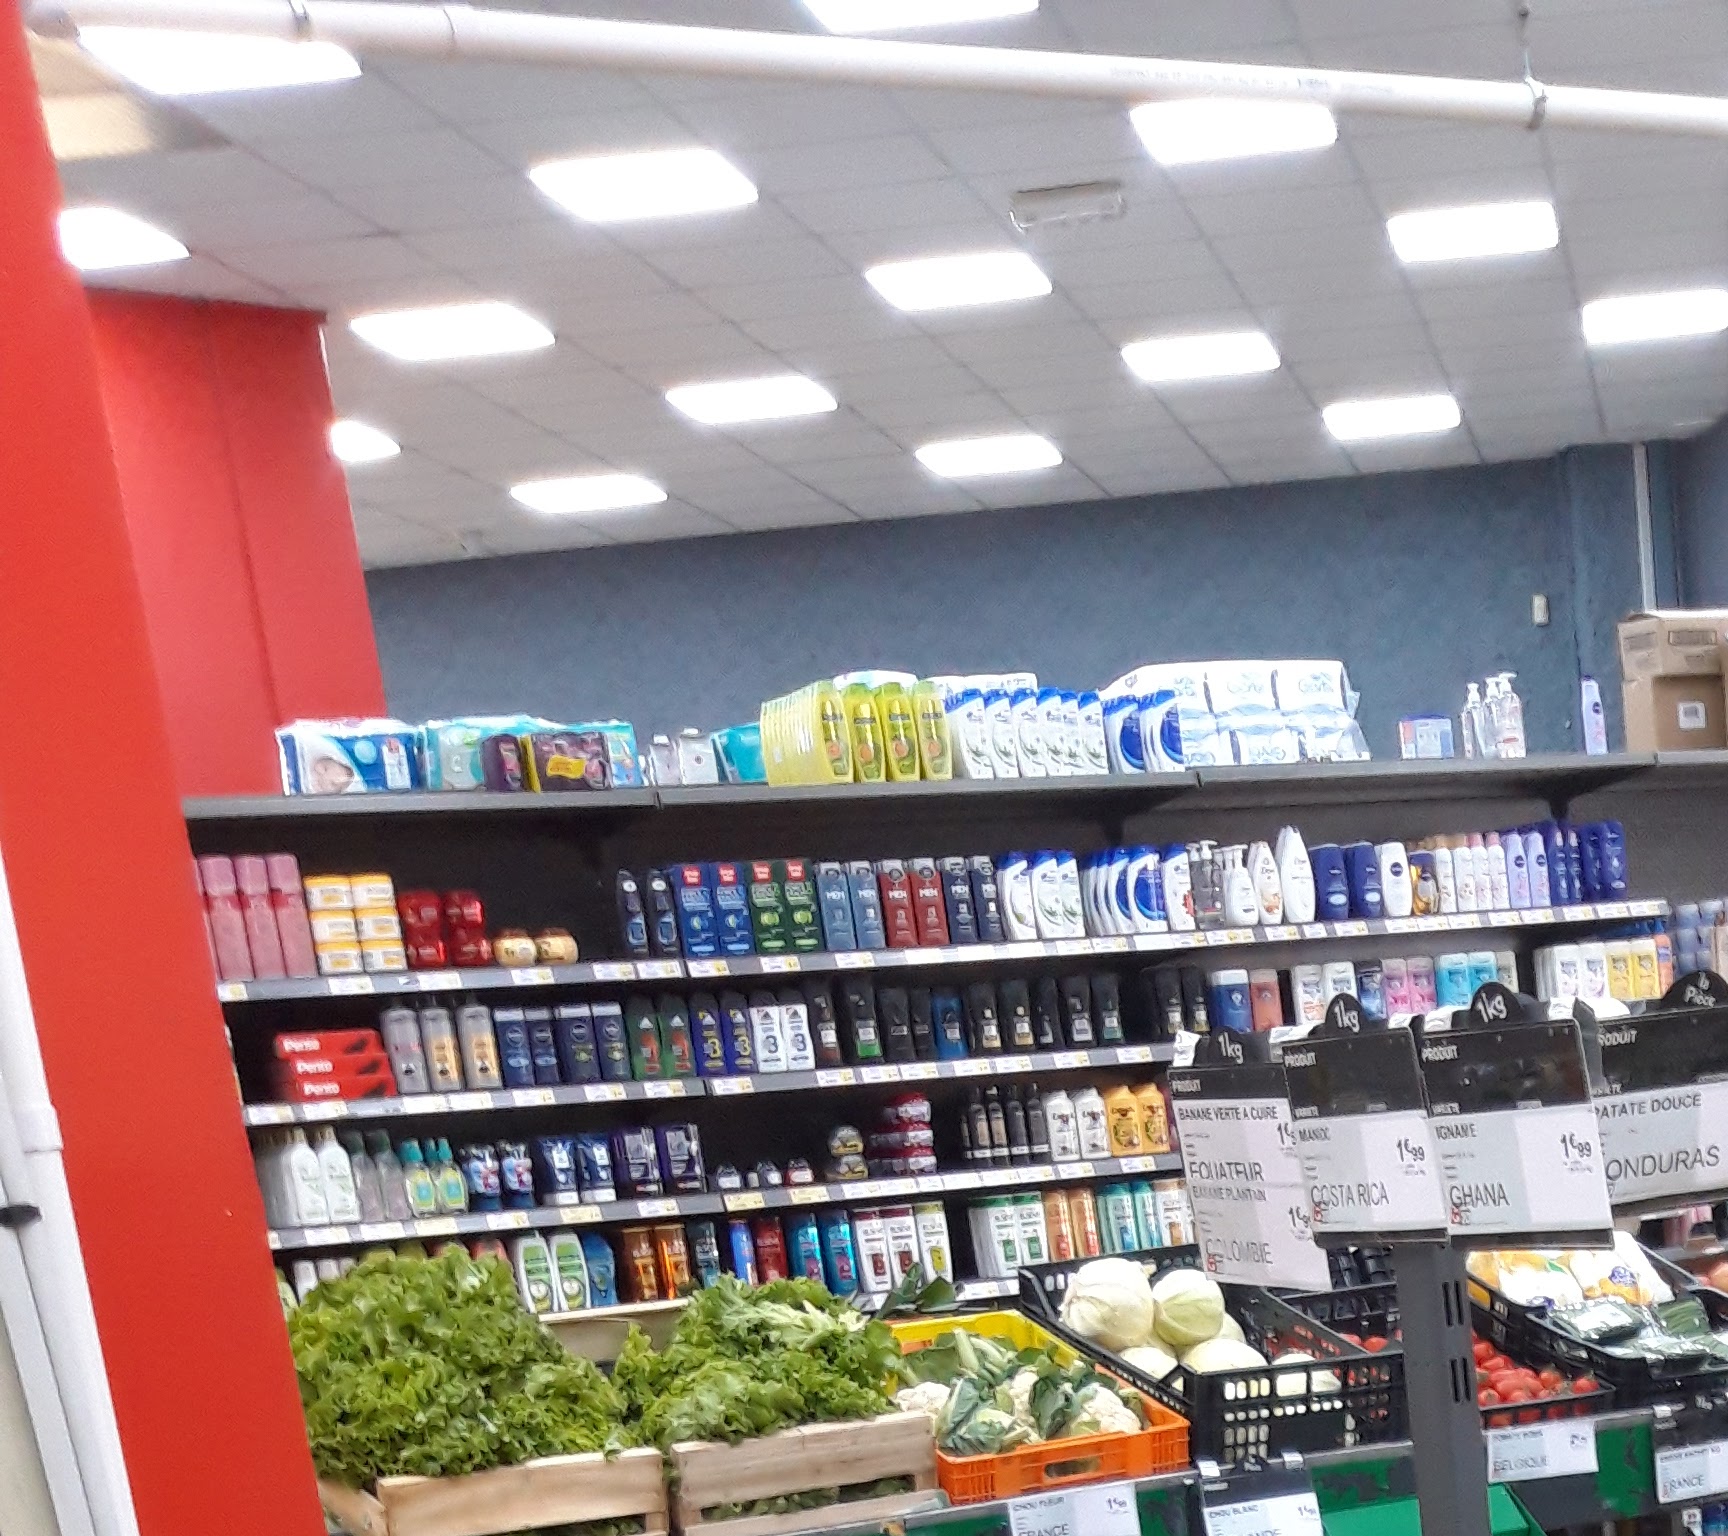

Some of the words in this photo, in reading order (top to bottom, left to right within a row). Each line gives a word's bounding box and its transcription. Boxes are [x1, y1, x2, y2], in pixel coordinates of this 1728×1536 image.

[1333, 999, 1361, 1033] 1kg
[1475, 992, 1508, 1023] 1kg
[1217, 1032, 1244, 1065] 1kg
[1284, 1052, 1317, 1067] PRODUIT
[1421, 1044, 1459, 1062] PRODUIT
[1178, 1107, 1213, 1121] BANANE
[1214, 1106, 1242, 1120] VERTE
[1250, 1106, 1278, 1120] CUIRE
[1652, 1095, 1702, 1113] DOUCE
[1435, 1123, 1478, 1141] IGNAME
[1606, 1145, 1721, 1181] ONDURAS
[1310, 1184, 1356, 1208] COSTA
[1358, 1181, 1390, 1207] RICA
[1450, 1182, 1511, 1208] GHANA
[1205, 1238, 1273, 1265] COLOMBIE
